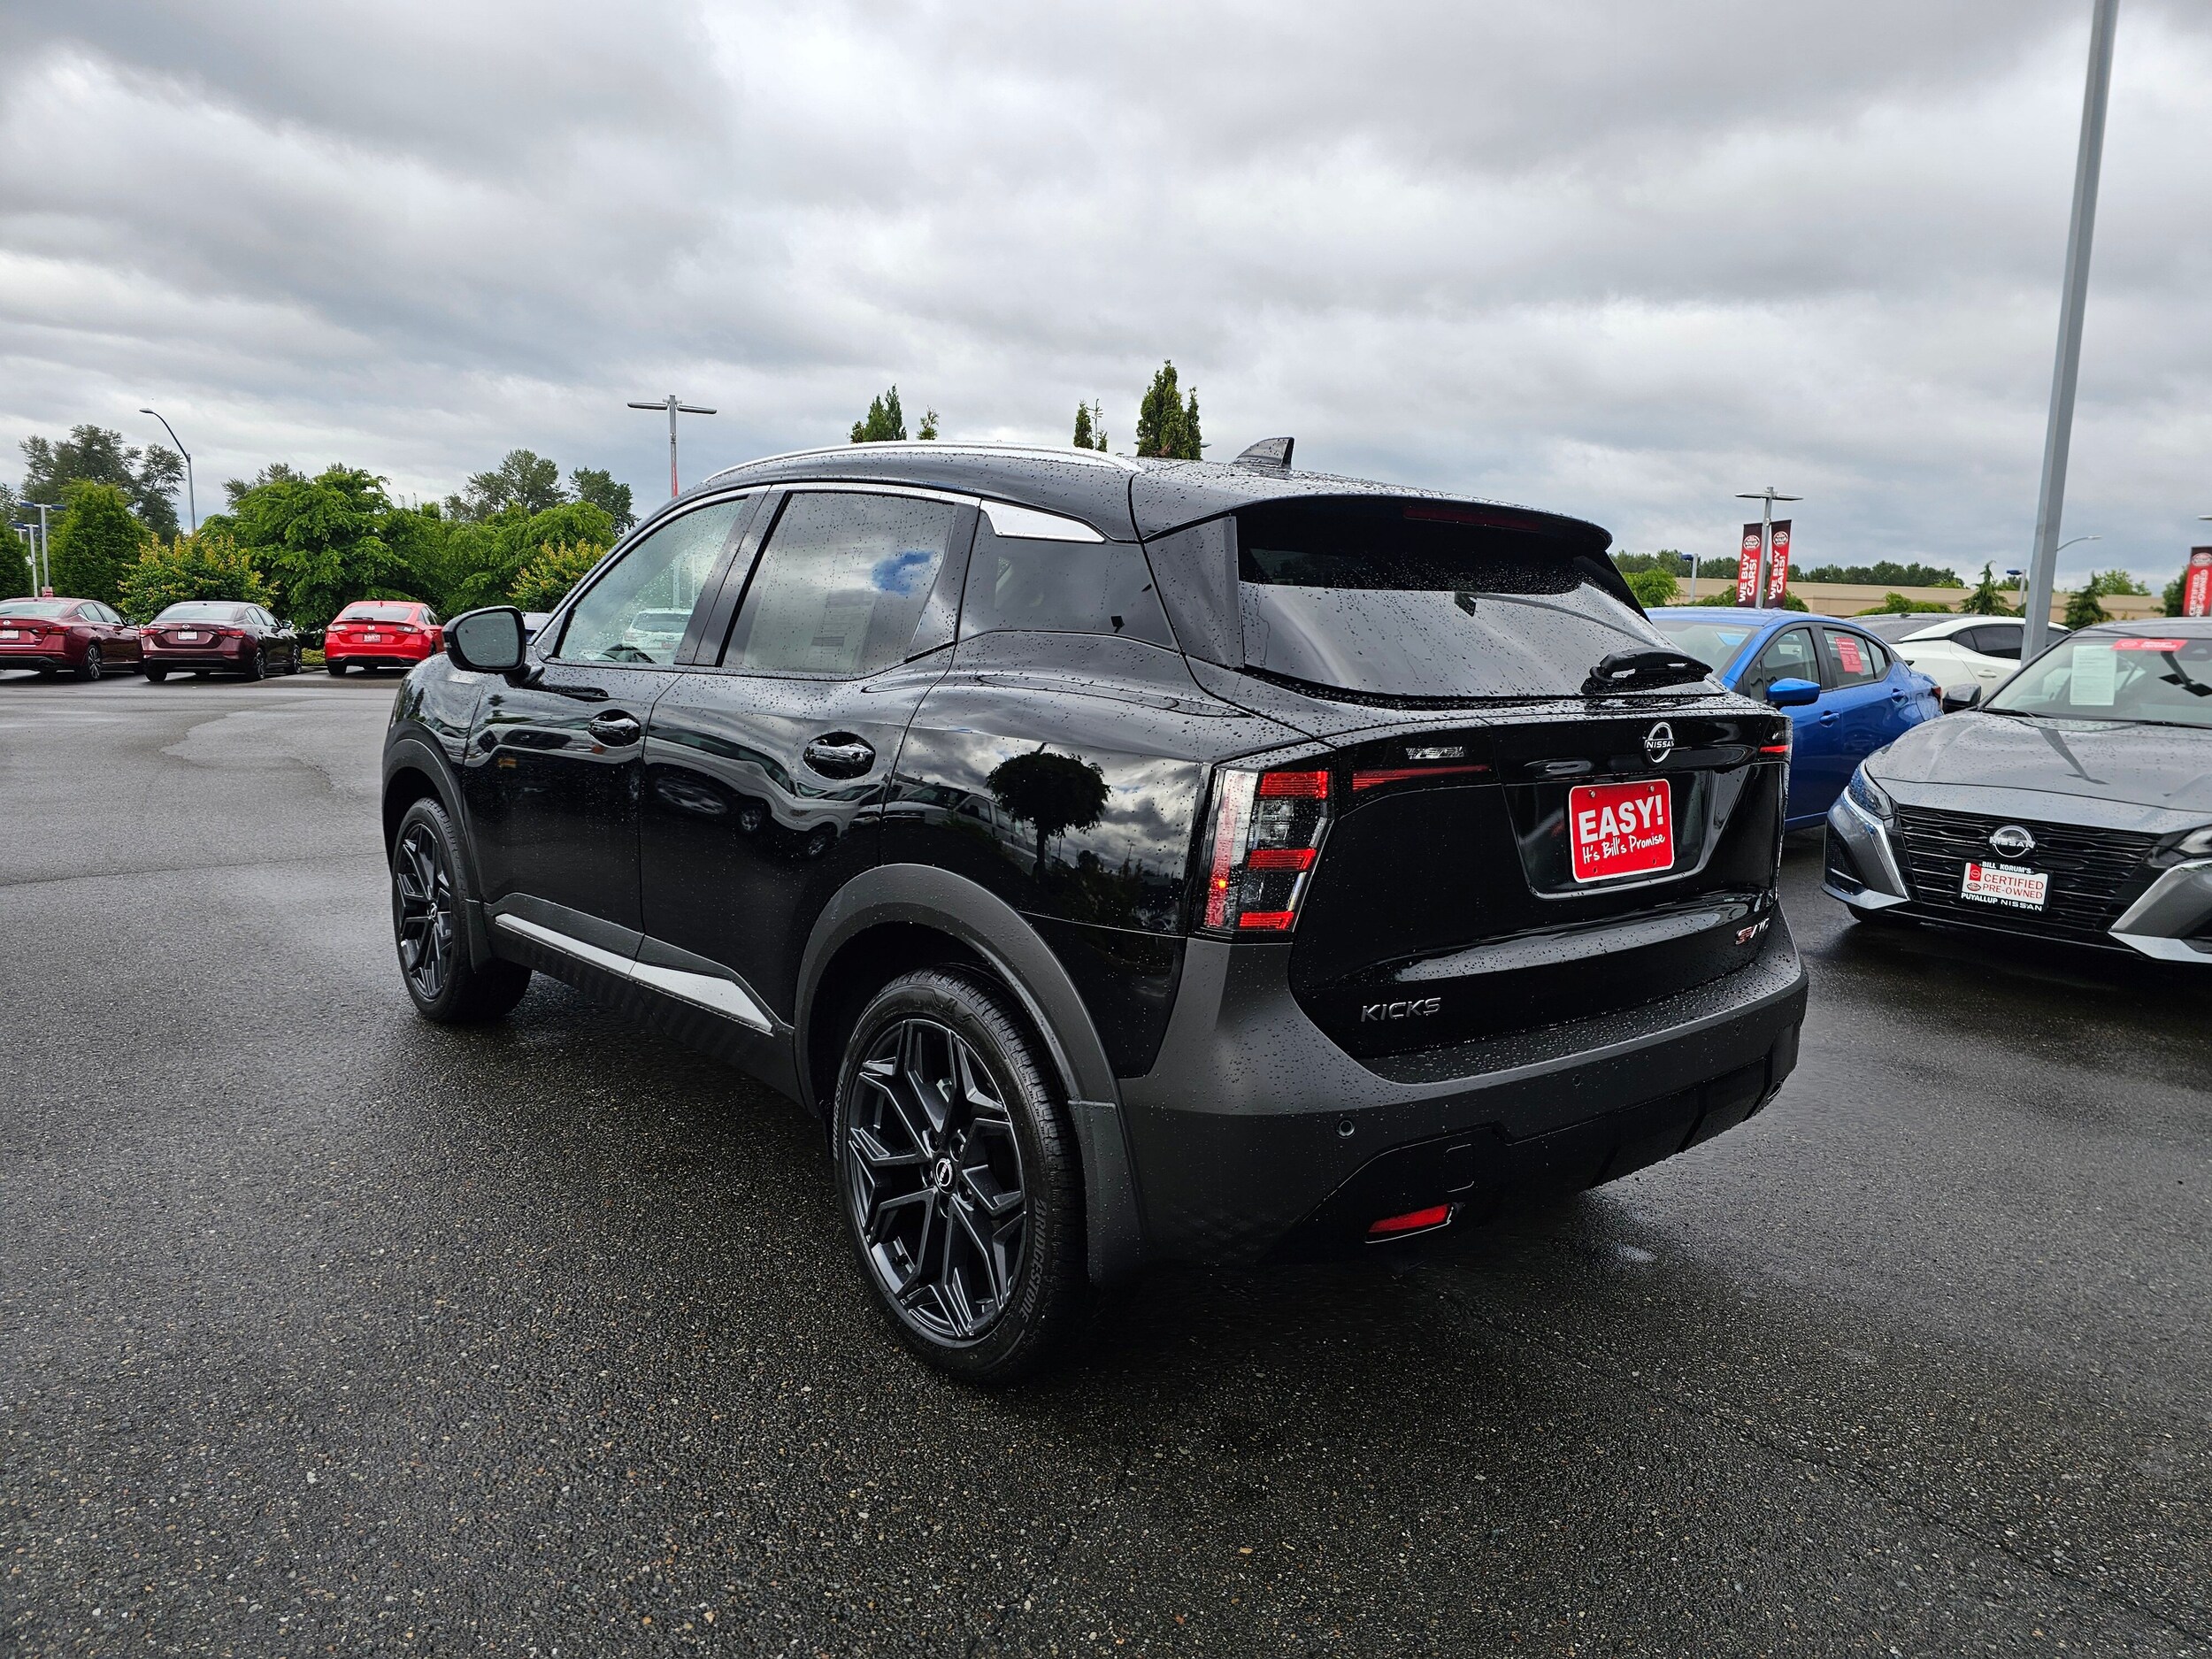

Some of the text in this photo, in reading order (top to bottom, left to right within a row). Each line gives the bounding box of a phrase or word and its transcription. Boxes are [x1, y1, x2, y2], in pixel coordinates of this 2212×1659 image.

[1739, 553, 1750, 603] WE BUY
[1747, 558, 1757, 596] CARS!
[1776, 555, 1786, 594] CARS!
[1769, 579, 1778, 600] WE
[2189, 573, 2200, 617] CERTIFIED
[1578, 795, 1663, 844] EASY!
[1582, 833, 1665, 864] It's Bill's Promise
[1989, 835, 2036, 849] NISSAN
[1984, 873, 2044, 890] CERTIFIED
[2000, 864, 2032, 874] KORUM'S
[1961, 892, 2043, 911] PUYALLUP NISSAN
[1982, 883, 2043, 899] PRE-OWNED
[1361, 997, 1441, 1022] KICKS
[1018, 1195, 1048, 1324] BRIDGESTONE
